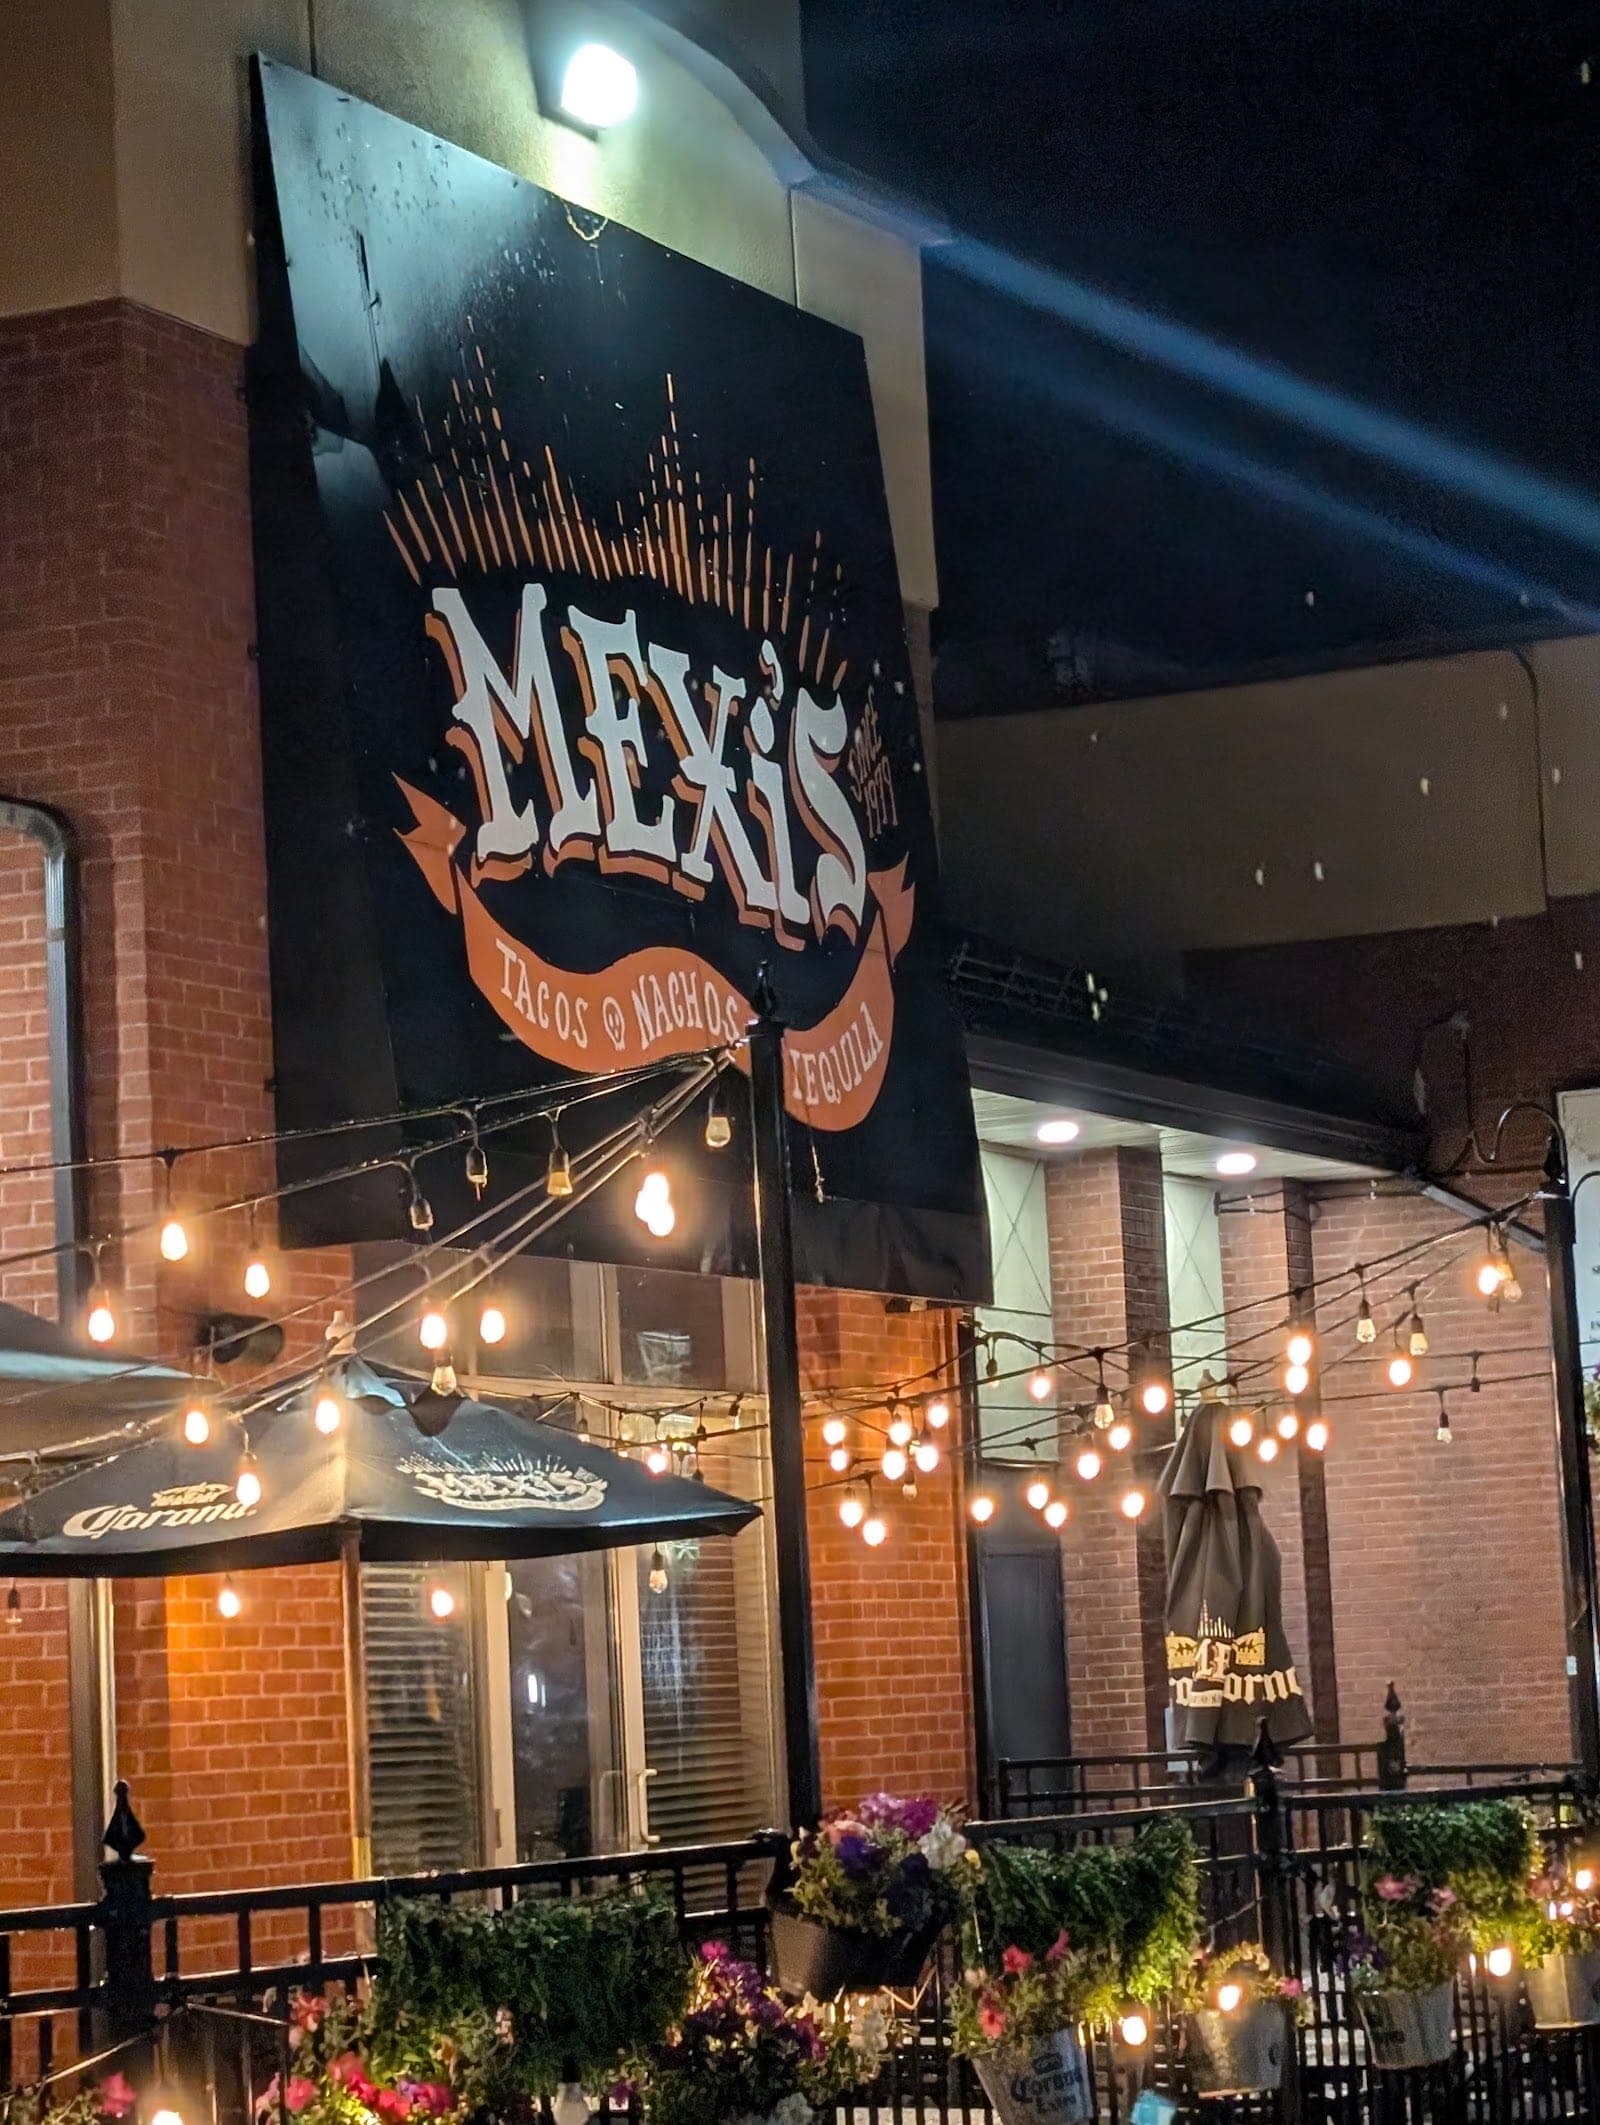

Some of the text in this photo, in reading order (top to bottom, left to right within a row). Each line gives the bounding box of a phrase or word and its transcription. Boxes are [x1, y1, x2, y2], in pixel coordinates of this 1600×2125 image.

[496, 938, 884, 1105] TACOS NACHOS TEQUILA
[63, 1503, 254, 1539] Corona
